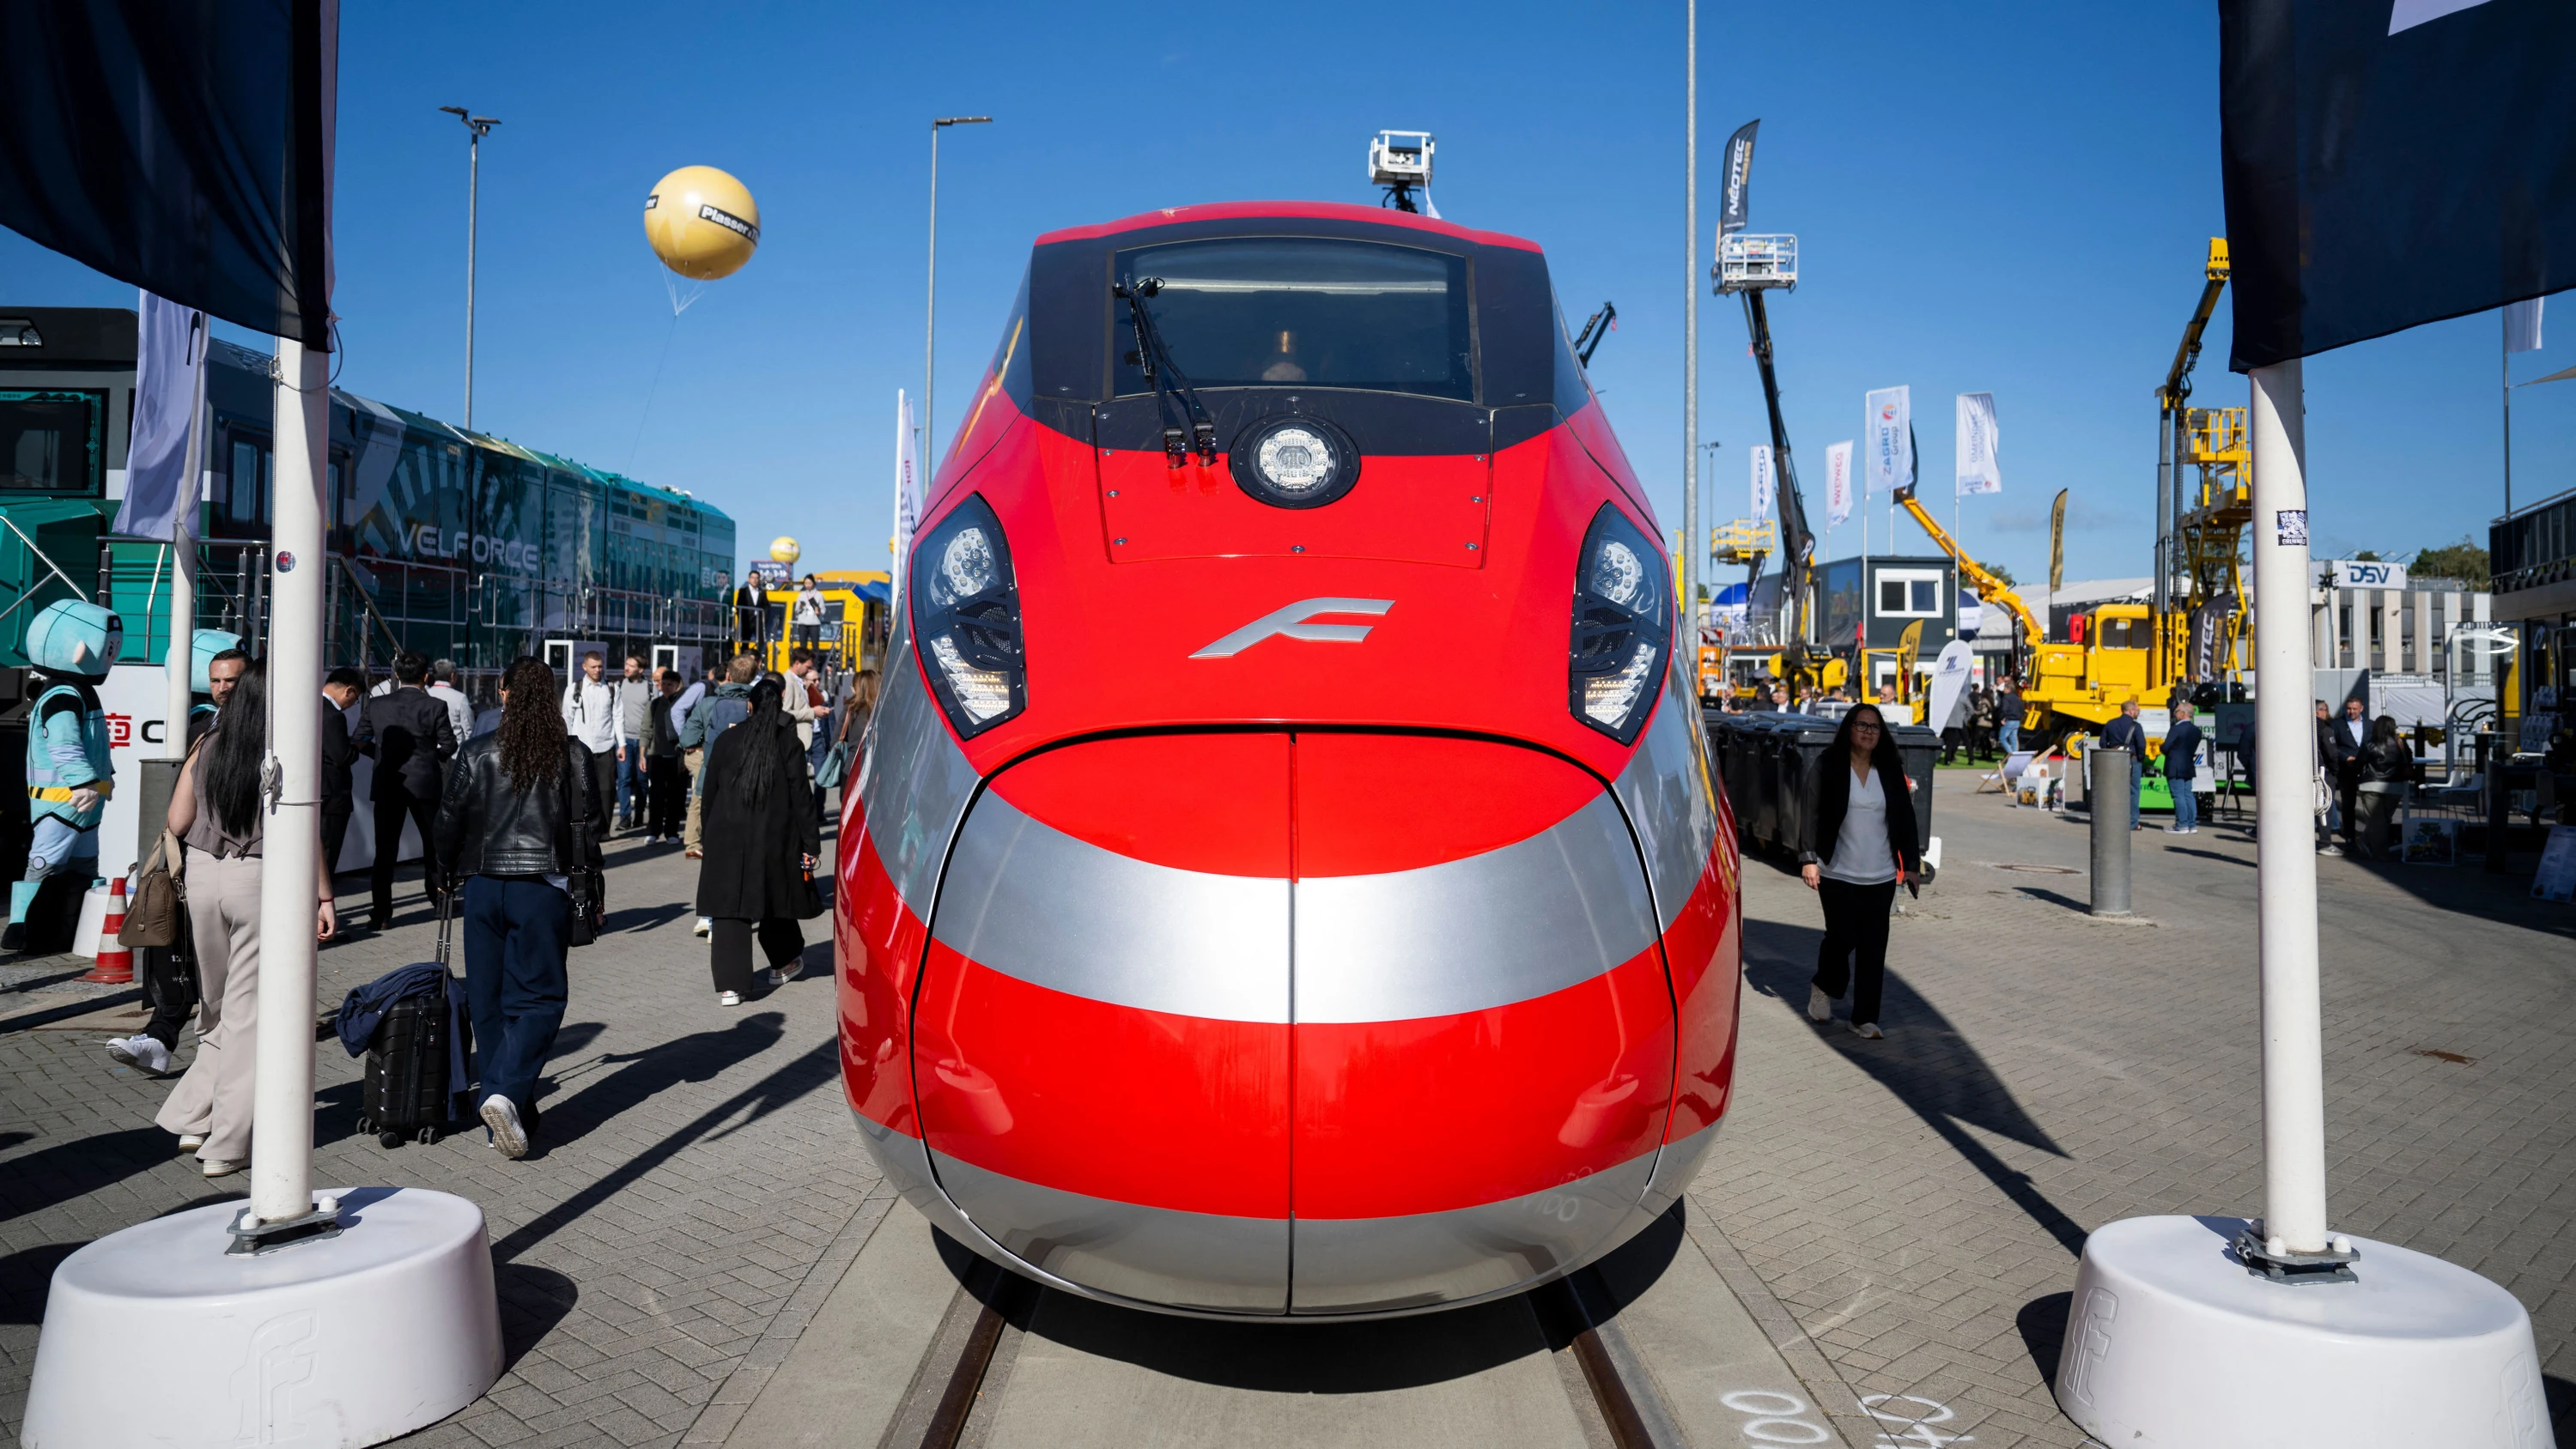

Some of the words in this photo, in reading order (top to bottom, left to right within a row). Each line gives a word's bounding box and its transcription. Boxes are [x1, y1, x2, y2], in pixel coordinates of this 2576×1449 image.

[702, 205, 750, 234] Plasser
[1881, 427, 1892, 476] ZAGRO
[396, 523, 538, 572] VELFORCE
[2350, 565, 2391, 584] DSV
